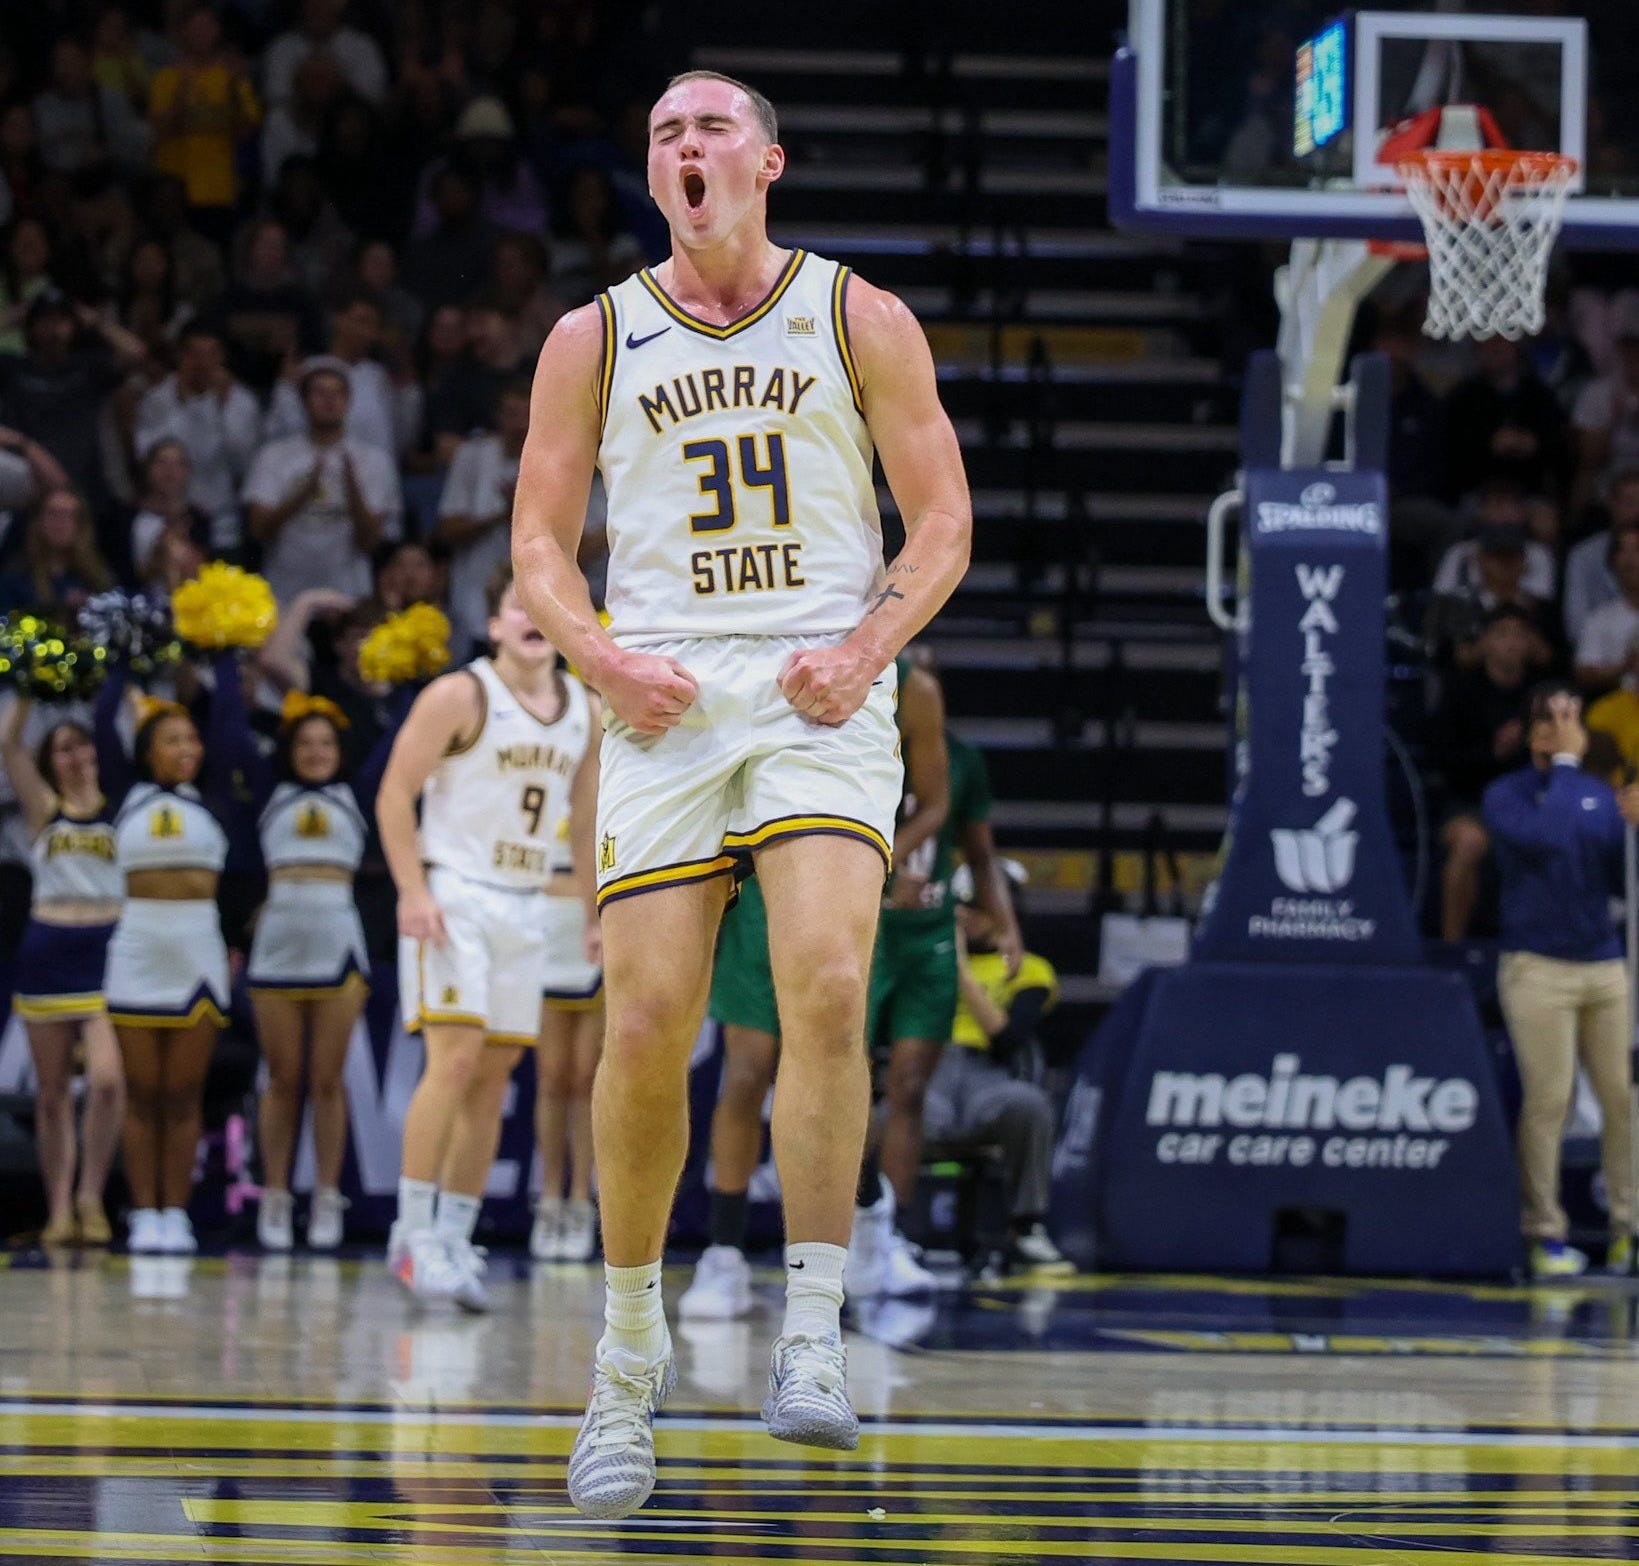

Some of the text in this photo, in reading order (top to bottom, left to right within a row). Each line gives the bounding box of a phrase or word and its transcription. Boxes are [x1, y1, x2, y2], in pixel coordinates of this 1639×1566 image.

[786, 317, 816, 331] VALLEY
[637, 365, 817, 434] MURRAY
[681, 431, 793, 535] 34
[1257, 501, 1381, 534] SPALDING
[691, 543, 806, 595] STATE
[520, 785, 546, 836] 9
[1248, 915, 1376, 941] PHARMACY
[1271, 897, 1354, 918] FAMILY
[1145, 1052, 1479, 1133] meineke
[1156, 1132, 1450, 1170] car care center
